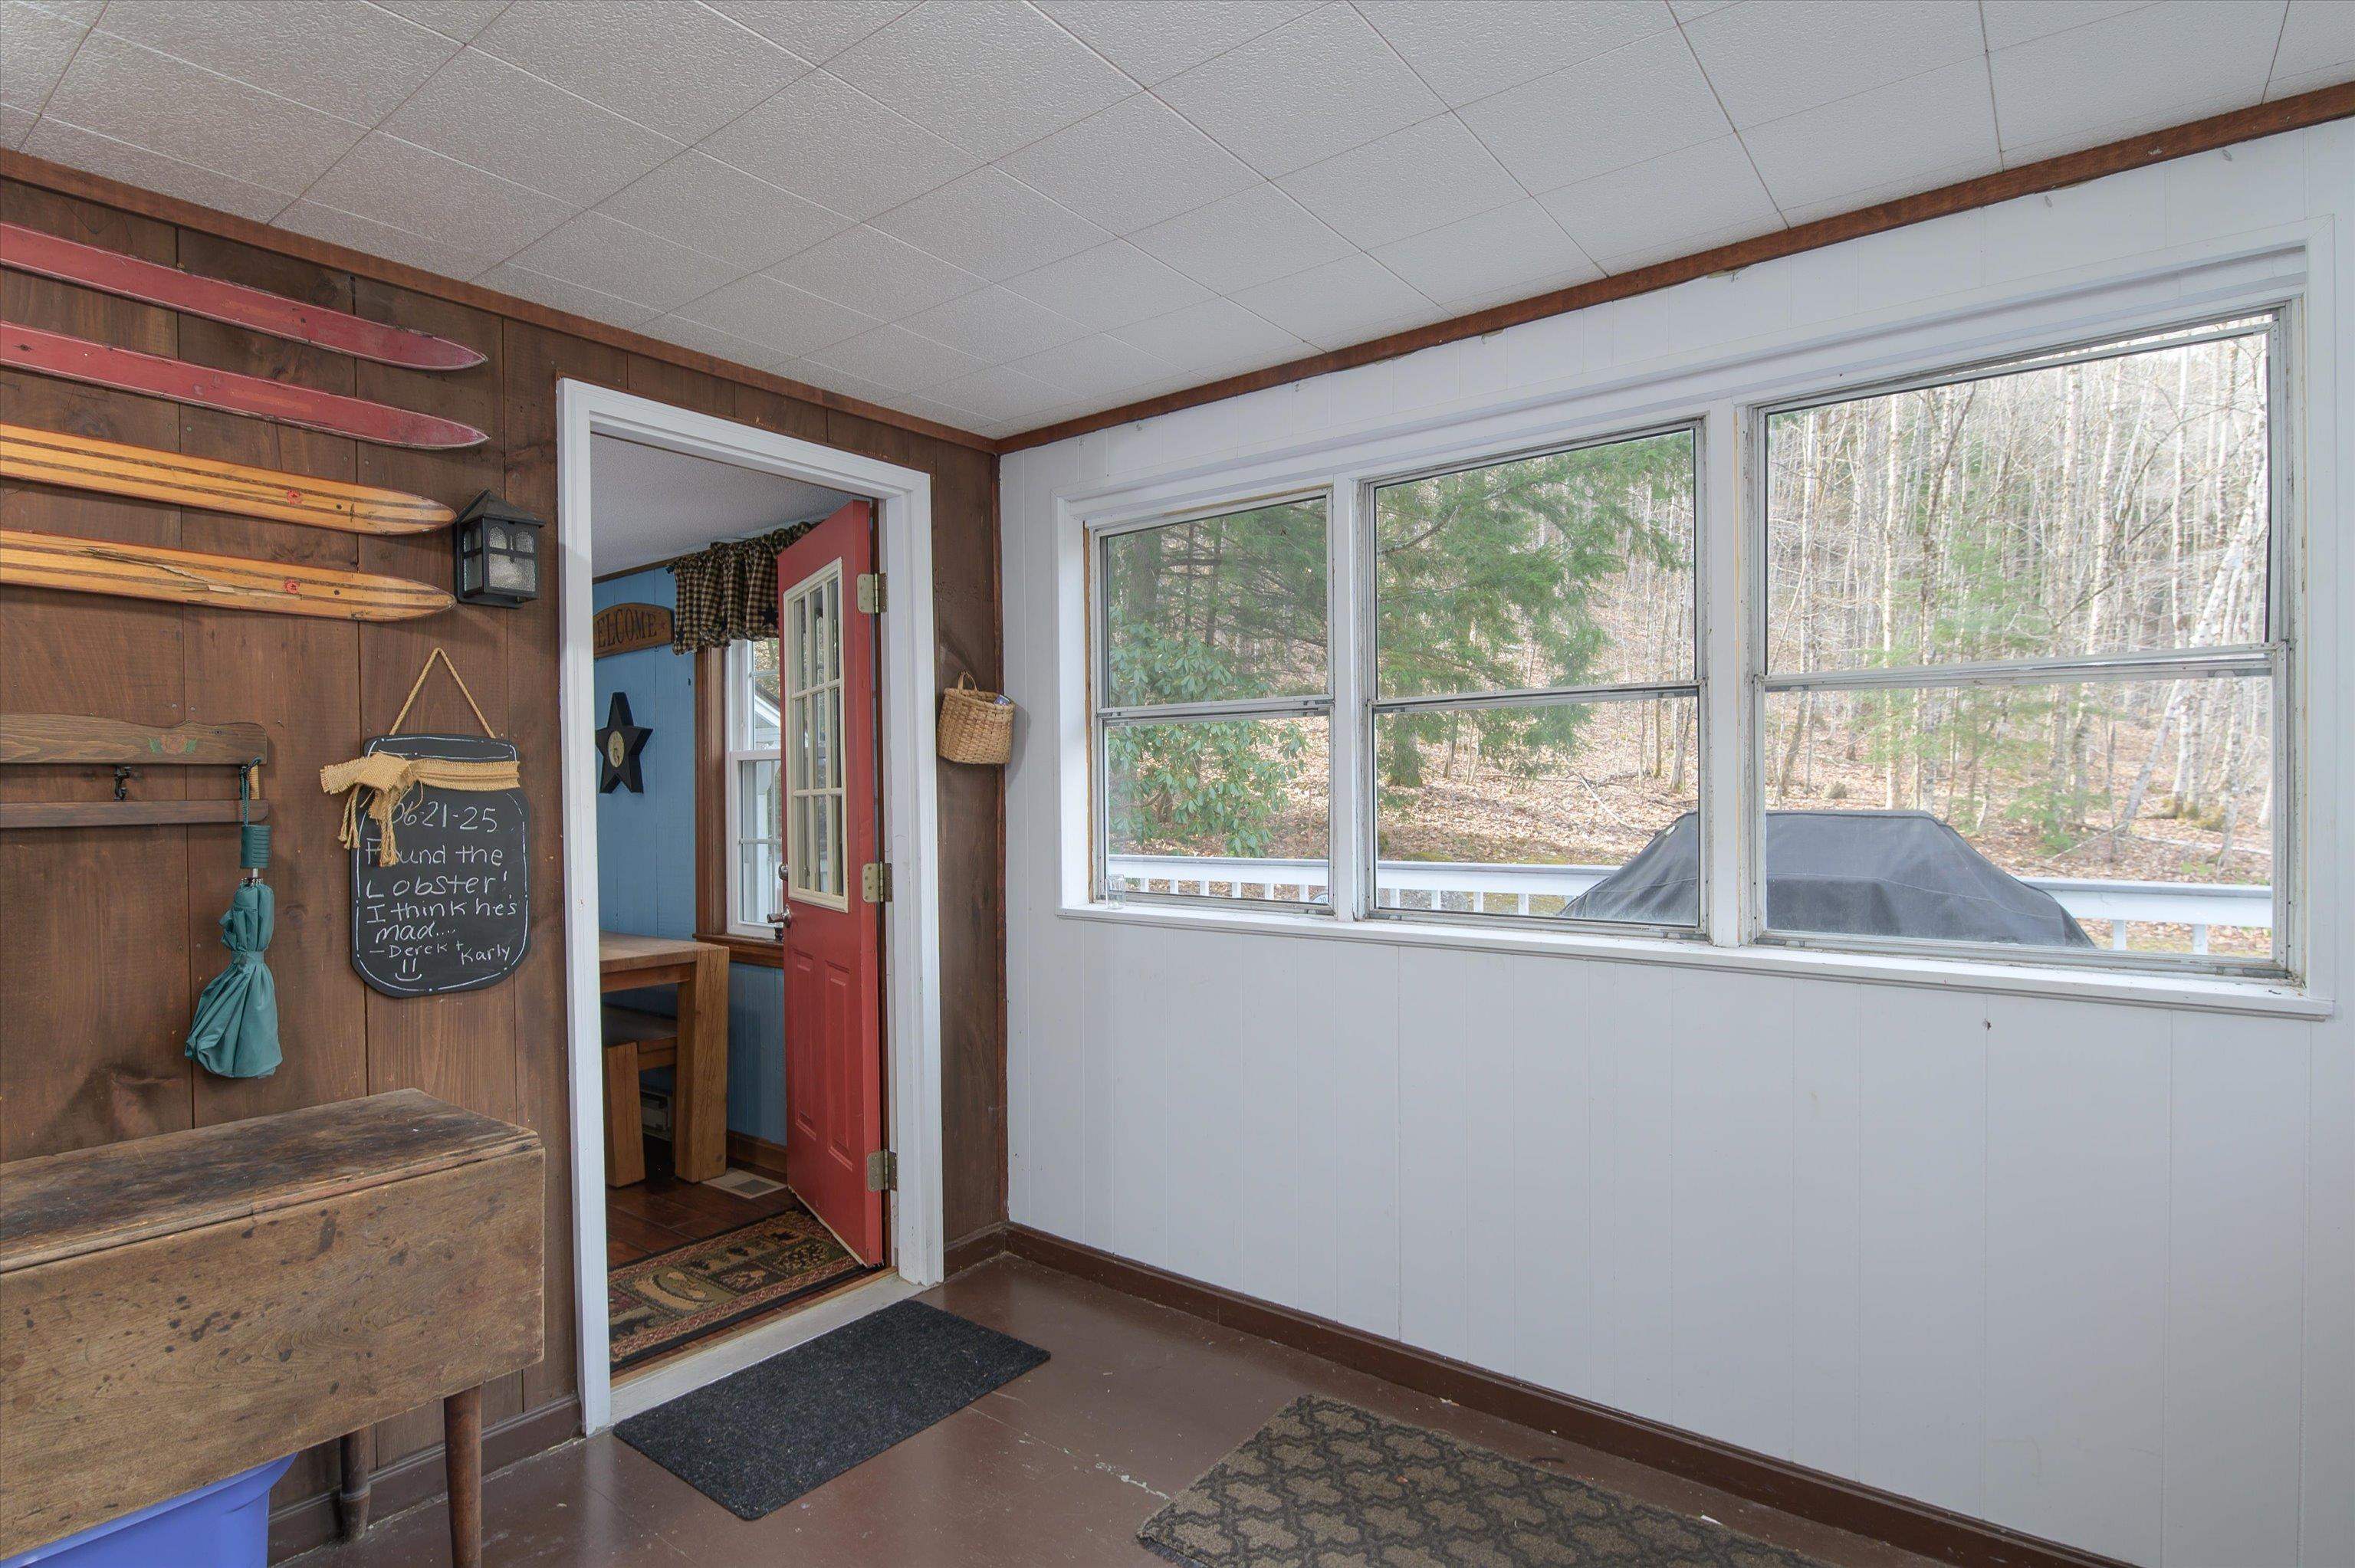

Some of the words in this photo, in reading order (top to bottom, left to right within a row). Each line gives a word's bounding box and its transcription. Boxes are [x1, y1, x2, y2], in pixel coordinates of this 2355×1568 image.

[597, 607, 657, 648] ELCOME
[366, 838, 446, 865] Fund
[455, 845, 503, 867] the
[366, 904, 386, 923] I
[390, 900, 468, 921] think
[475, 894, 517, 917] he's
[461, 943, 511, 966] Karly
